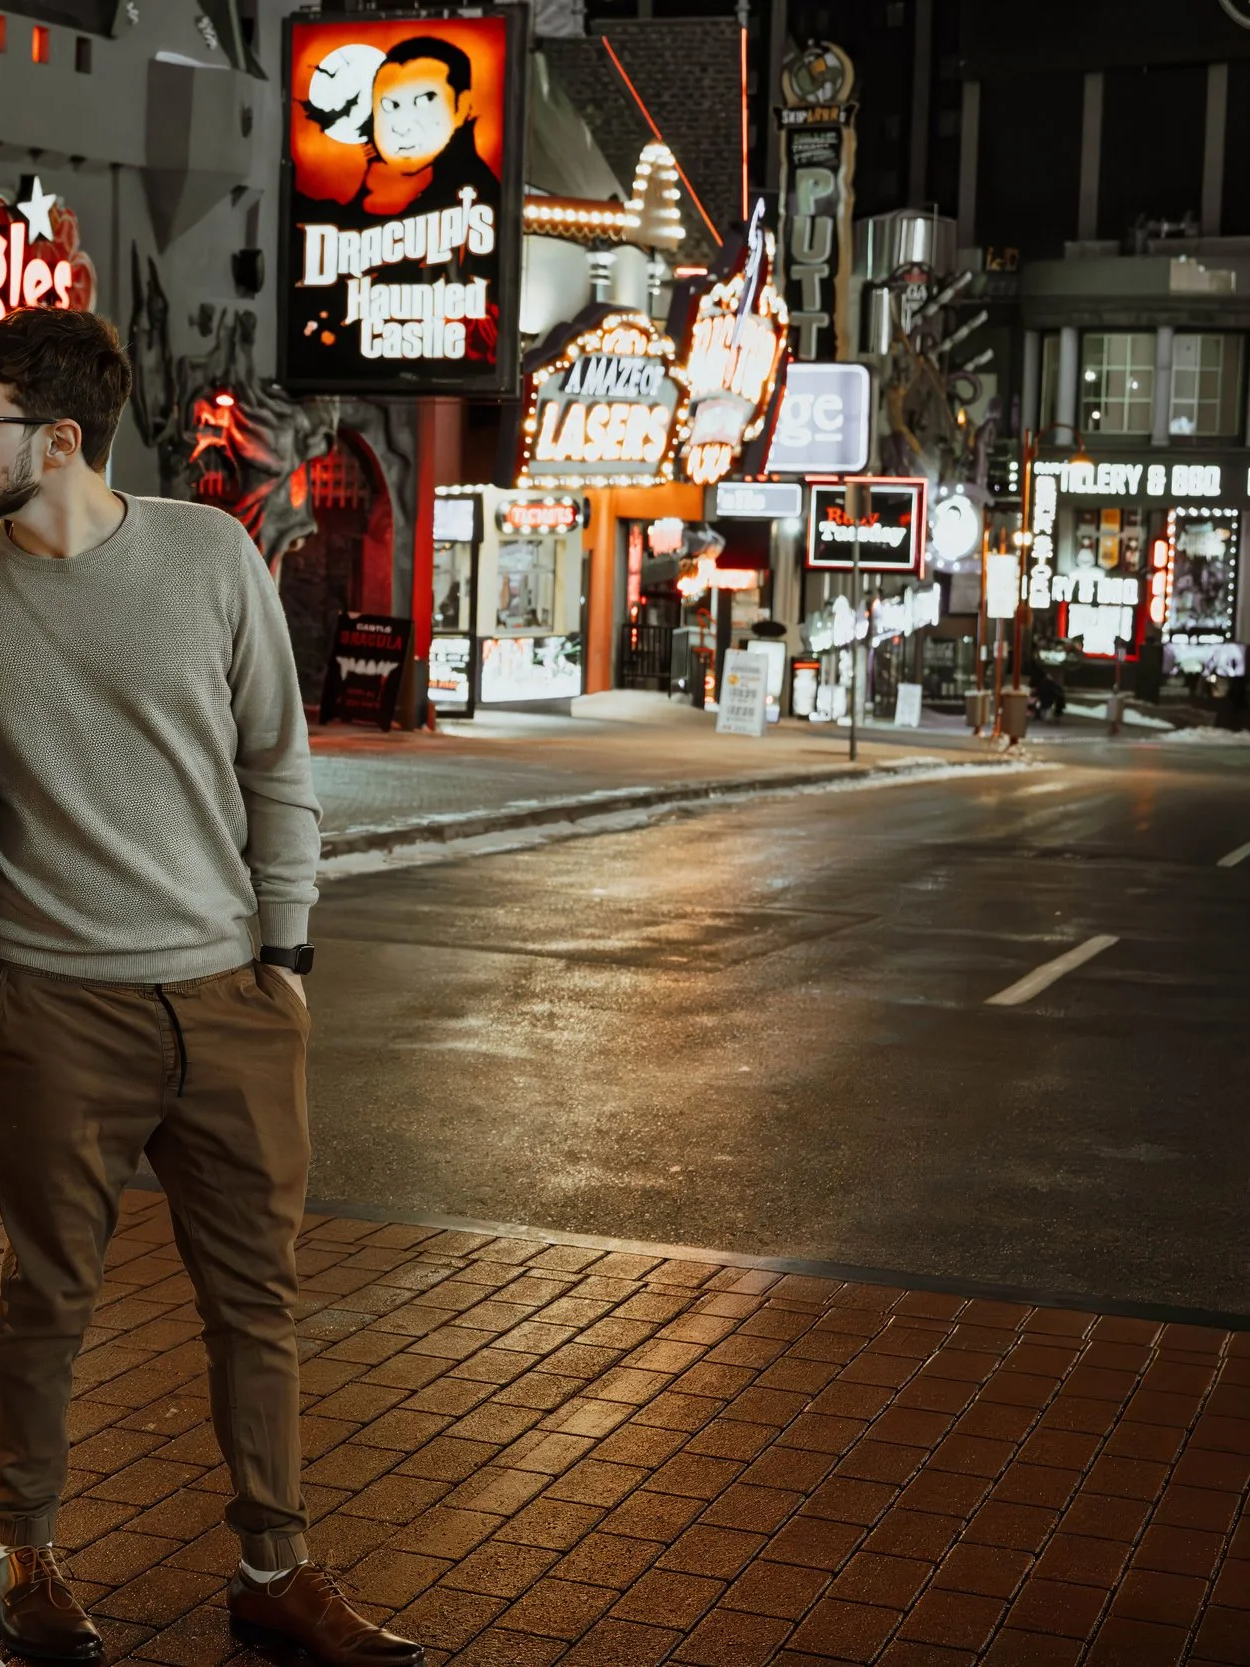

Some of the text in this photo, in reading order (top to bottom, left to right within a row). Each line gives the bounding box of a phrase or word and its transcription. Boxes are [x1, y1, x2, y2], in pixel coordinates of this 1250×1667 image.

[790, 168, 835, 360] PUTT
[347, 275, 488, 323] Haunted
[360, 317, 467, 360] Castle
[536, 401, 669, 462] LASERS
[512, 507, 573, 524] TICKETS
[340, 631, 403, 649] DRACULA
